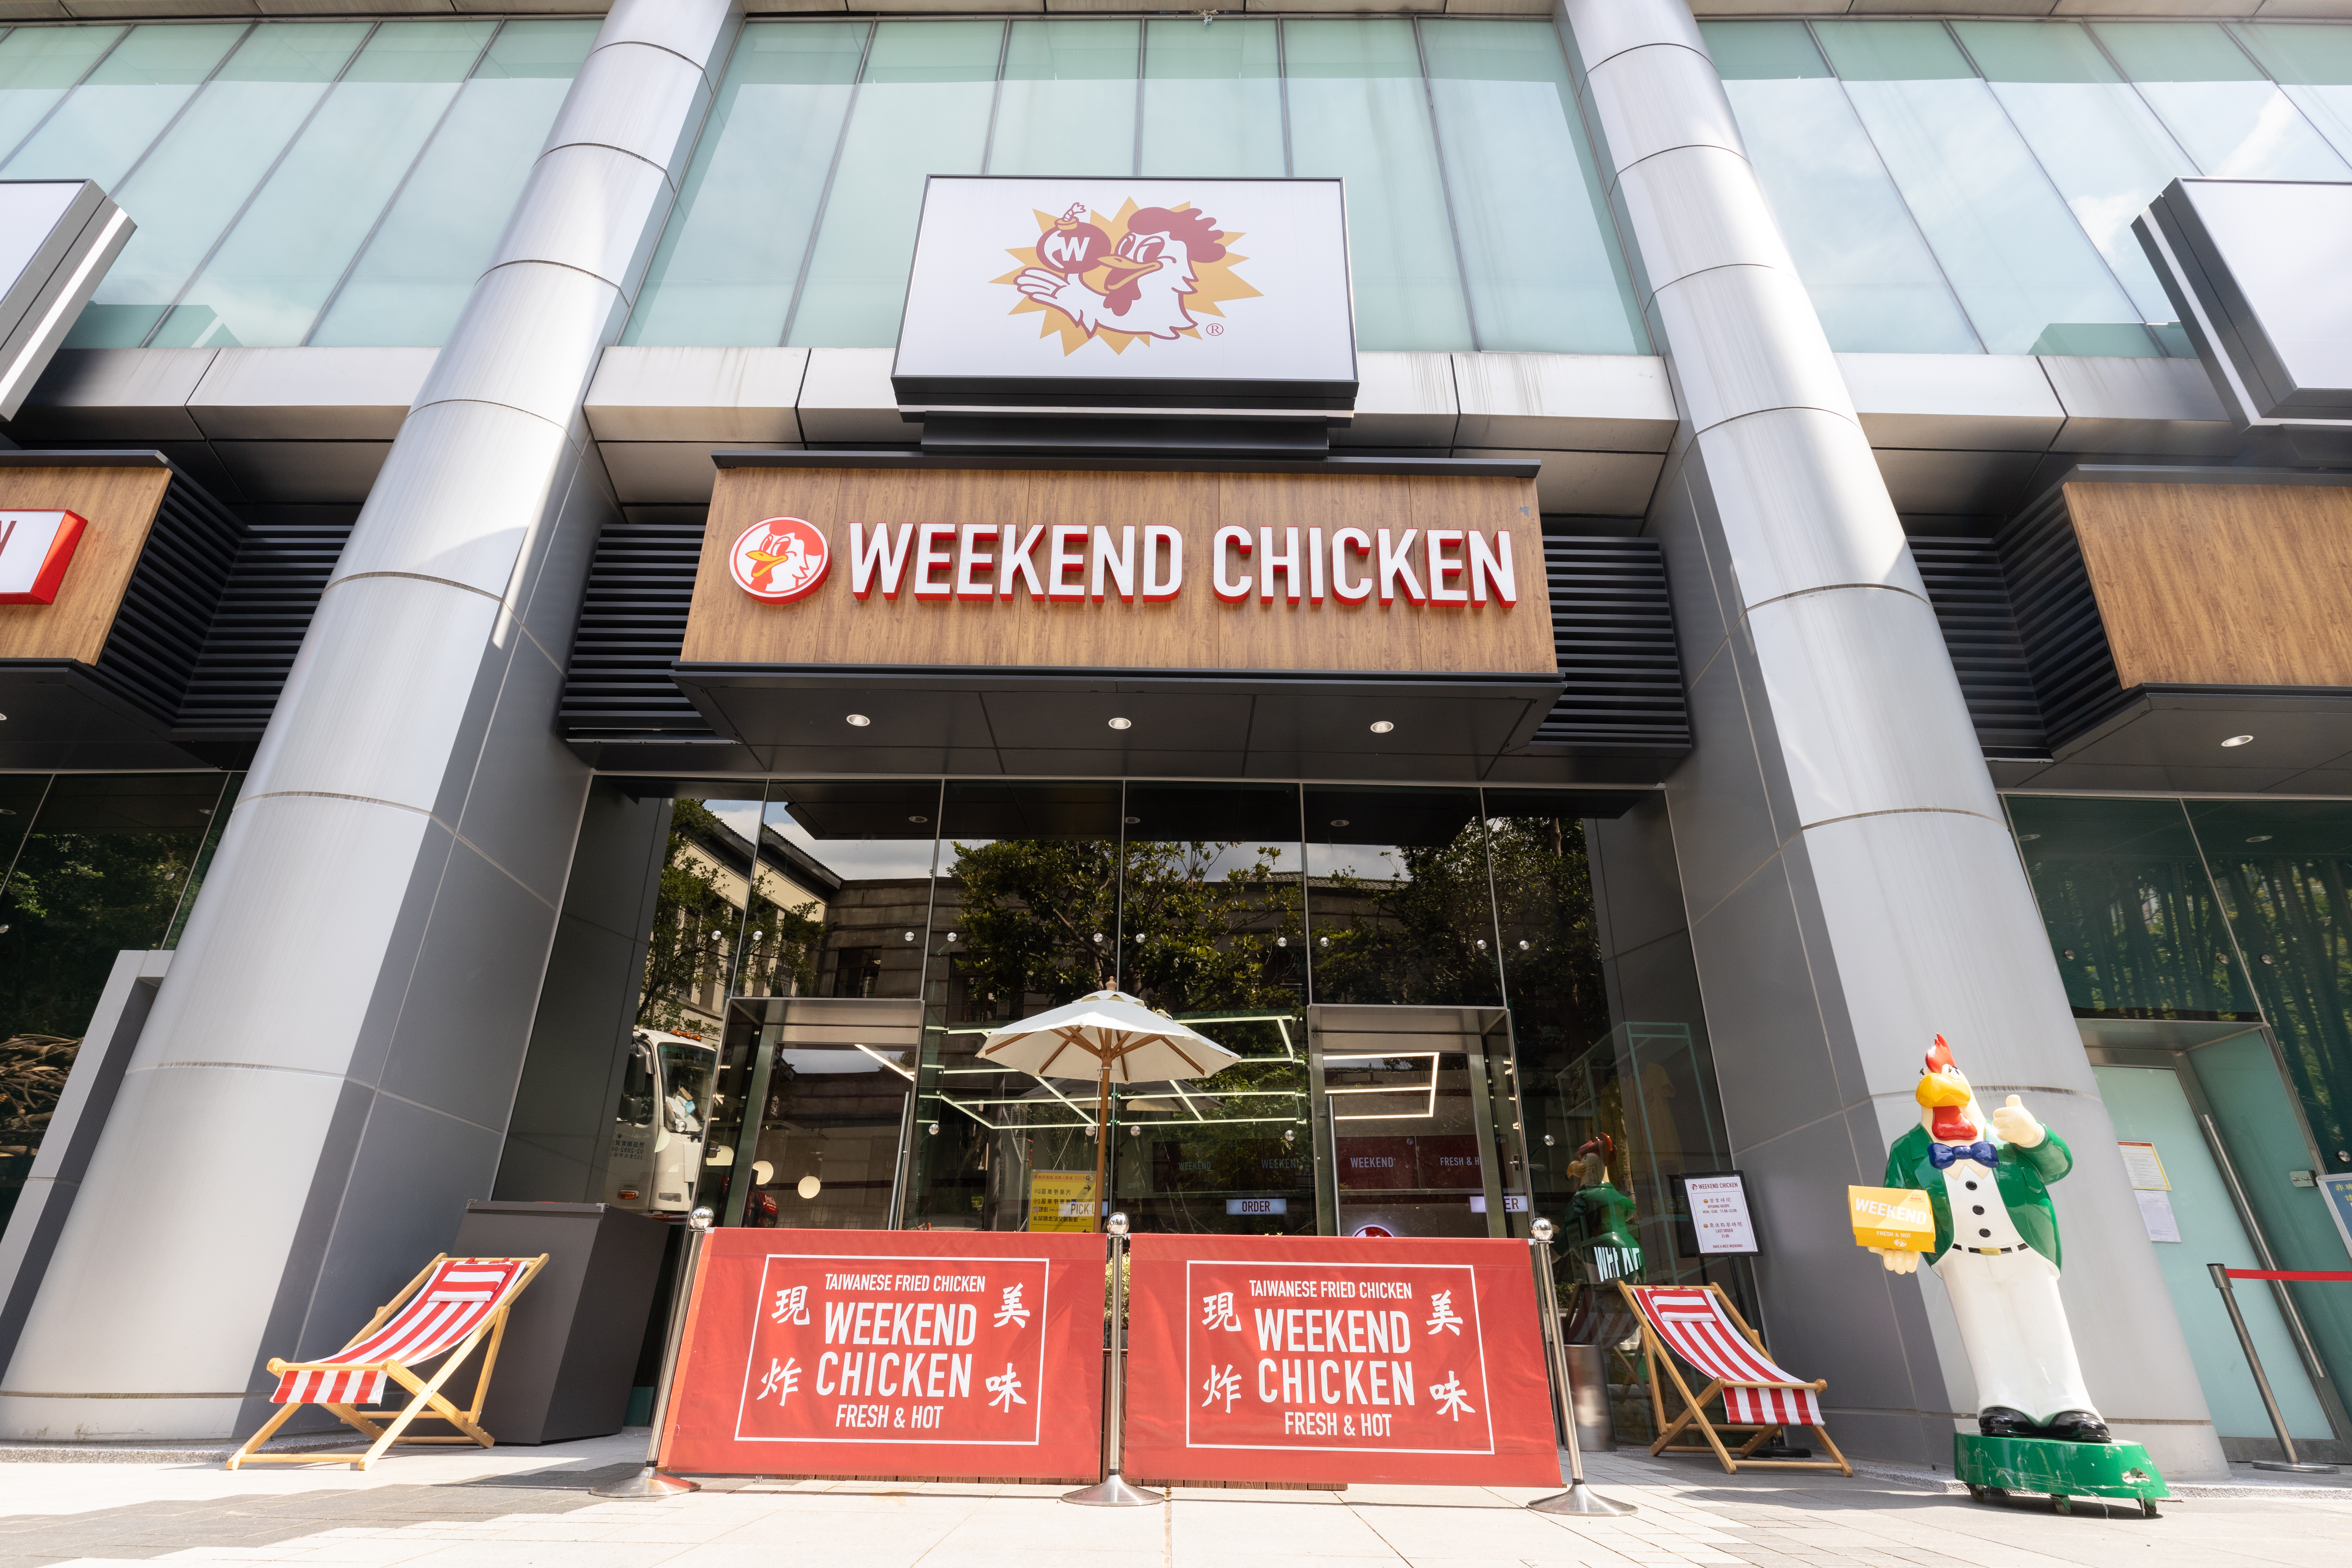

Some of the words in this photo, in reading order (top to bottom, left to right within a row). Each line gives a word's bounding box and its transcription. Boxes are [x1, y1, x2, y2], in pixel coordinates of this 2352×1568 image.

[1060, 237, 1091, 261] W
[849, 522, 1183, 603] WEEKEND
[1213, 525, 1517, 608] CHICKEN
[1178, 1161, 1211, 1170] WEEKEND
[1350, 1157, 1393, 1168] WEEKEND
[1440, 1157, 1464, 1166] FRESH
[1071, 1204, 1089, 1215] PICK
[1242, 1201, 1271, 1212] ORDER
[1856, 1197, 1927, 1225] WEEKEND
[826, 1274, 892, 1290] TAIWANESE
[895, 1275, 930, 1291] FRIED
[933, 1275, 985, 1292] CHICKEN
[1249, 1280, 1317, 1297] TAIWANESE
[1321, 1281, 1355, 1297] FRIED
[1360, 1282, 1412, 1298] CHICKEN
[826, 1302, 976, 1346] WEEKEND
[1255, 1309, 1410, 1353] WEEKEND
[816, 1352, 972, 1397] CHICKEN
[1259, 1358, 1415, 1405] CHICKEN
[836, 1404, 889, 1427] FRESH
[894, 1407, 905, 1428] &
[911, 1406, 943, 1428] HOT
[1285, 1412, 1337, 1435] FRESH
[1344, 1415, 1355, 1436] &
[1361, 1413, 1392, 1436] HOT
